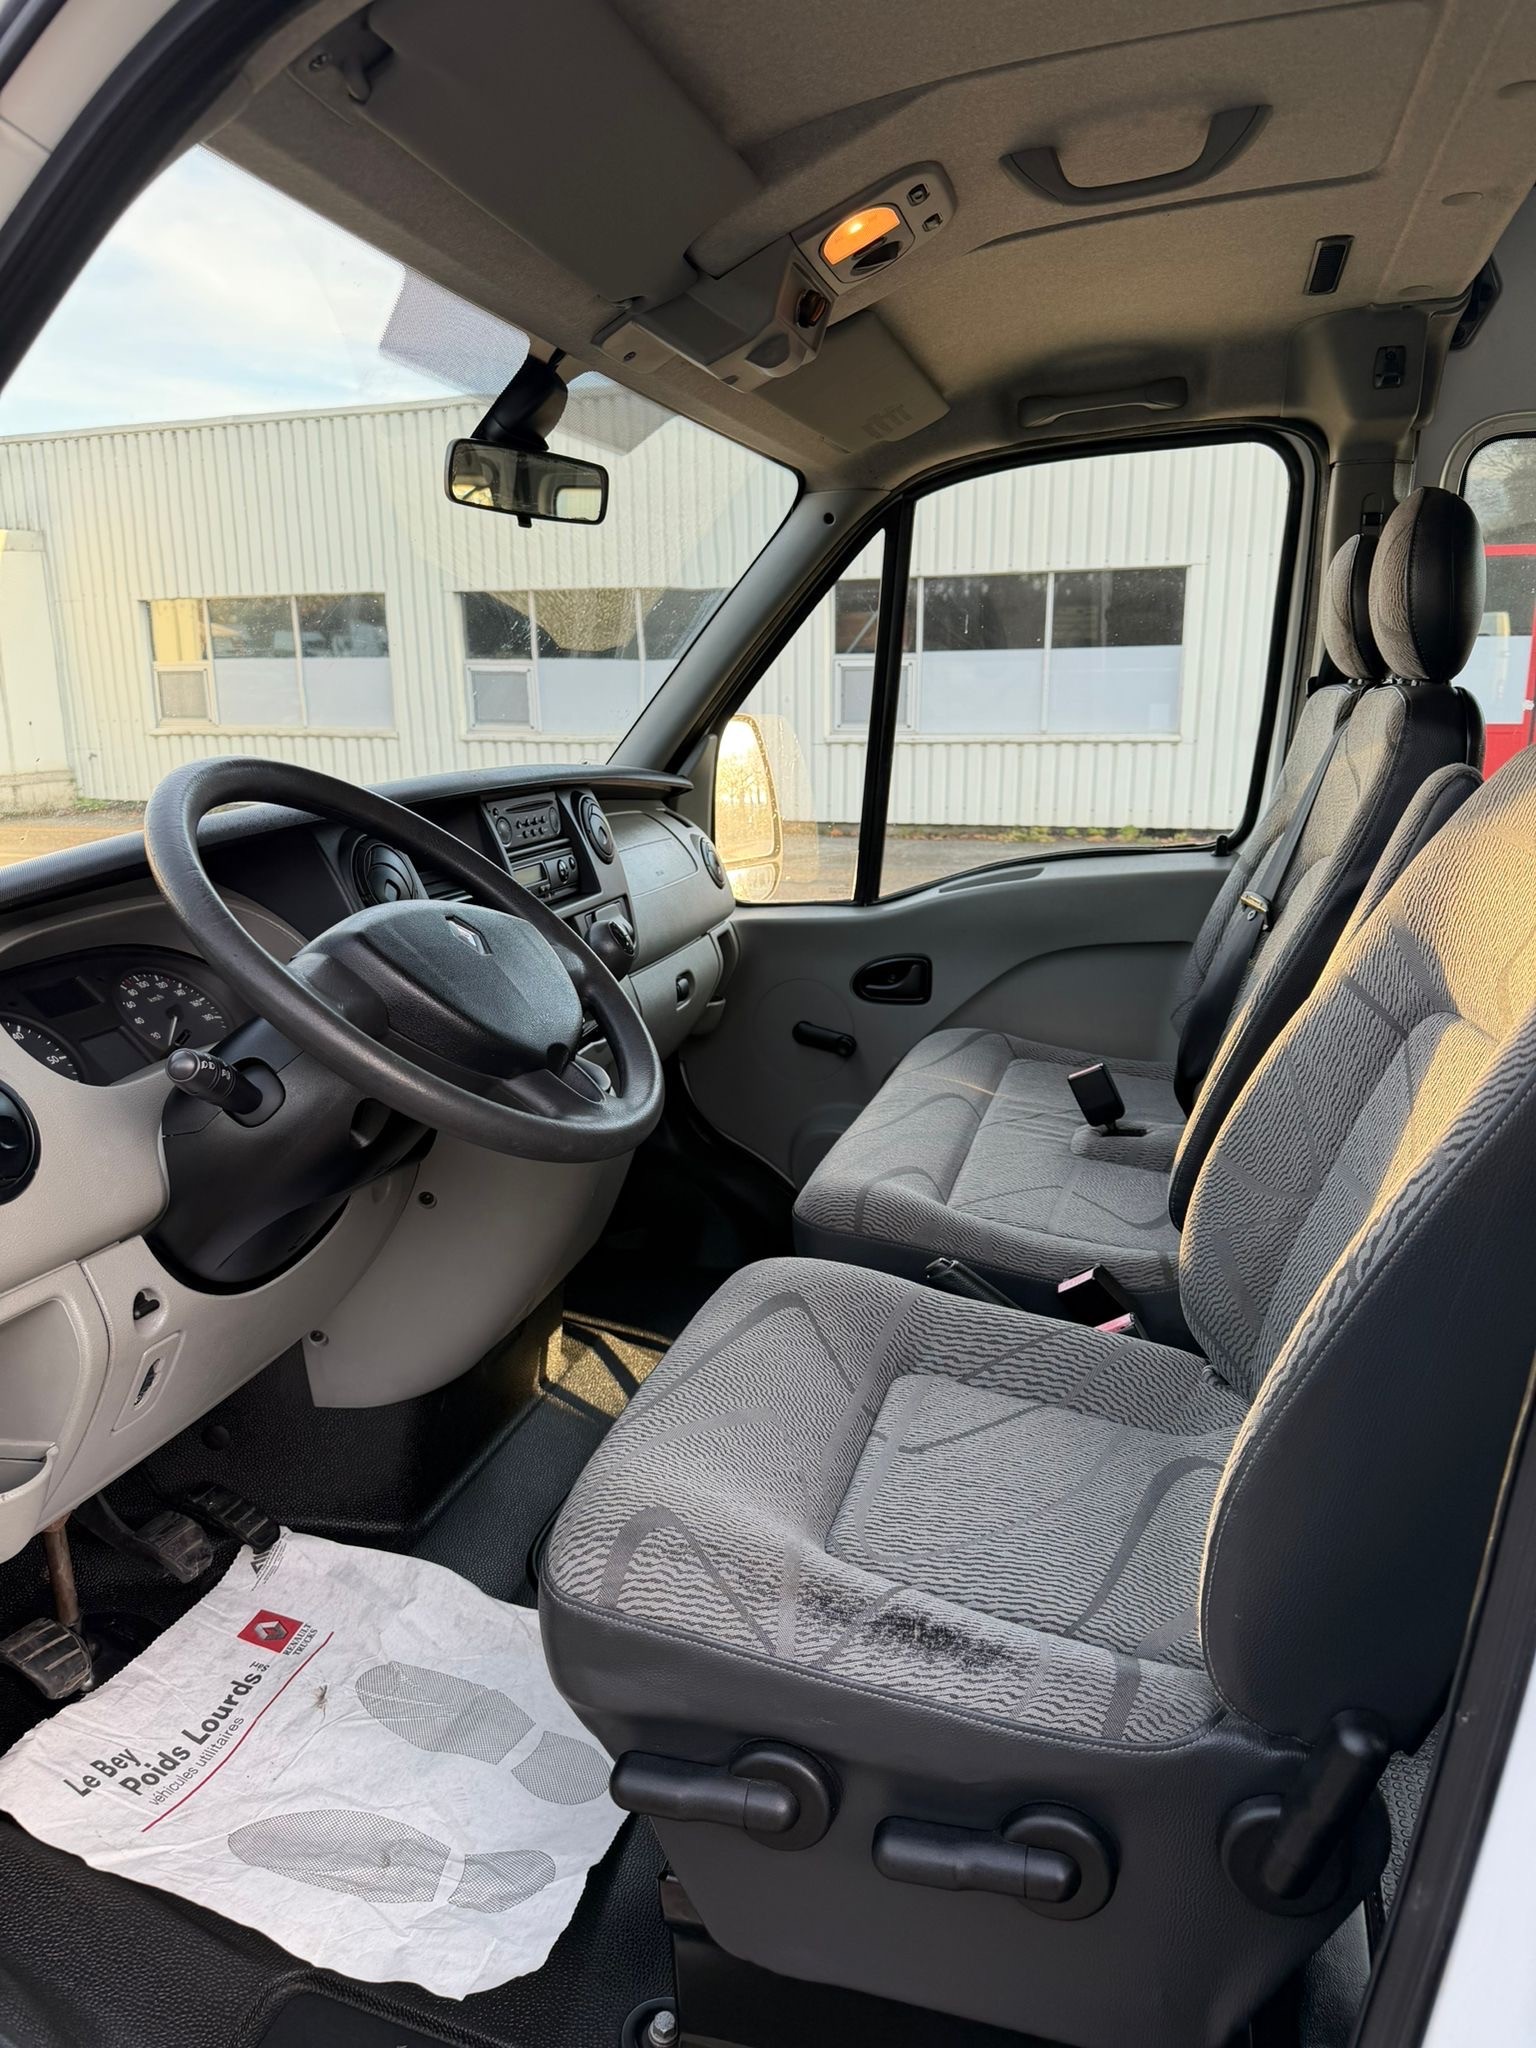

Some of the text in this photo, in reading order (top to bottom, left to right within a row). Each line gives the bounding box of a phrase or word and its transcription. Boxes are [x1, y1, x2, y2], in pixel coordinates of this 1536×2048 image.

[126, 1001, 137, 1009] 60
[127, 989, 138, 997] 80
[134, 1017, 145, 1025] 40
[46, 1055, 60, 1065] 50
[282, 1623, 312, 1656] RENAULT
[292, 1628, 319, 1656] TRUCKS
[118, 1745, 191, 1796] Poids
[181, 1672, 262, 1746] Lourds
[63, 1748, 142, 1798] Le Bey
[148, 1716, 244, 1807] véhicules utilitaires
